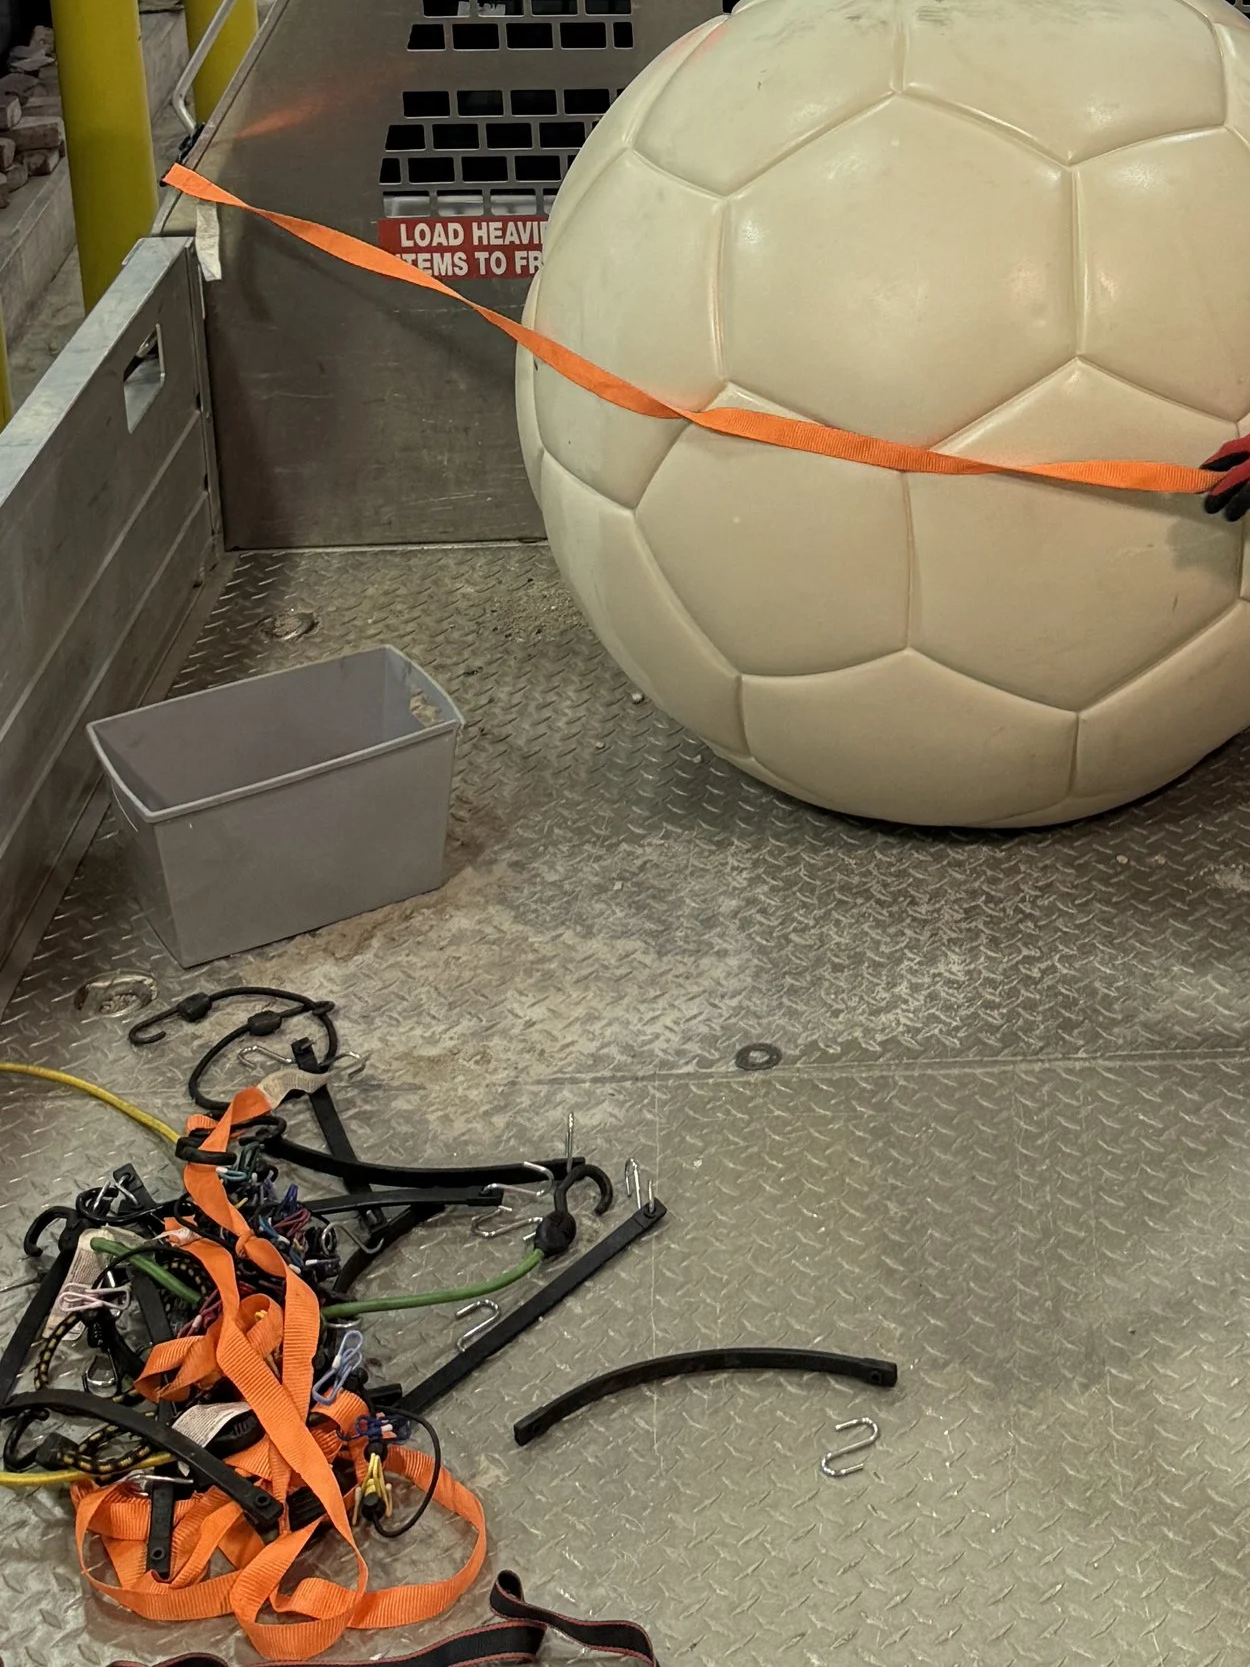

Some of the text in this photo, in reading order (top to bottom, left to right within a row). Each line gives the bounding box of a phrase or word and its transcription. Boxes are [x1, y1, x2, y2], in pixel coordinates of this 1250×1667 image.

[399, 221, 464, 248] LOAD
[396, 250, 469, 277] TEMS
[475, 250, 507, 276] TO
